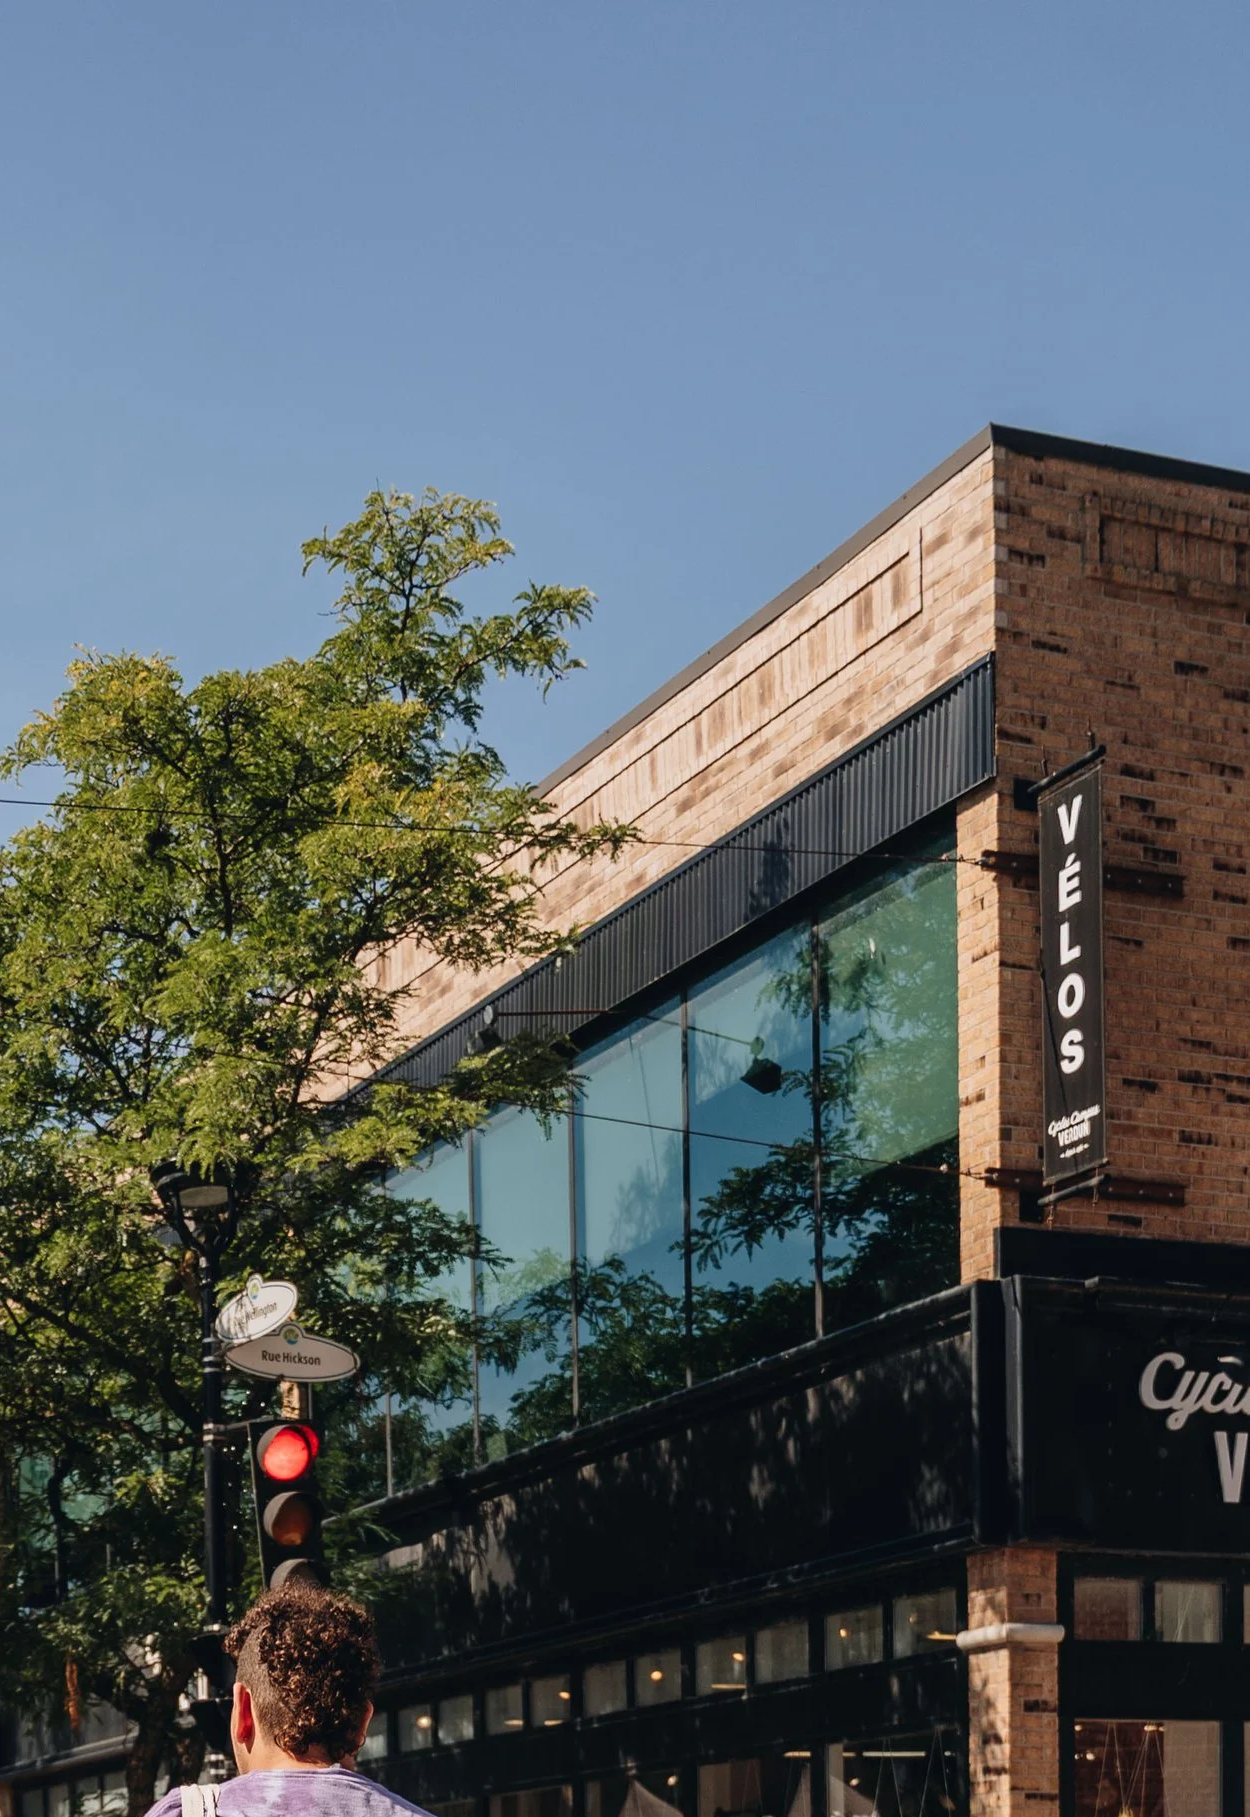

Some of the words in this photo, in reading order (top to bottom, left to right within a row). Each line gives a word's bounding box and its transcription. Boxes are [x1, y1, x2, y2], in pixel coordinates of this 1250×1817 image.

[1057, 794, 1086, 1075] VÉLOS
[1057, 1119, 1091, 1147] VERDUN
[261, 1350, 281, 1363] Rue
[282, 1351, 321, 1366] Hickson
